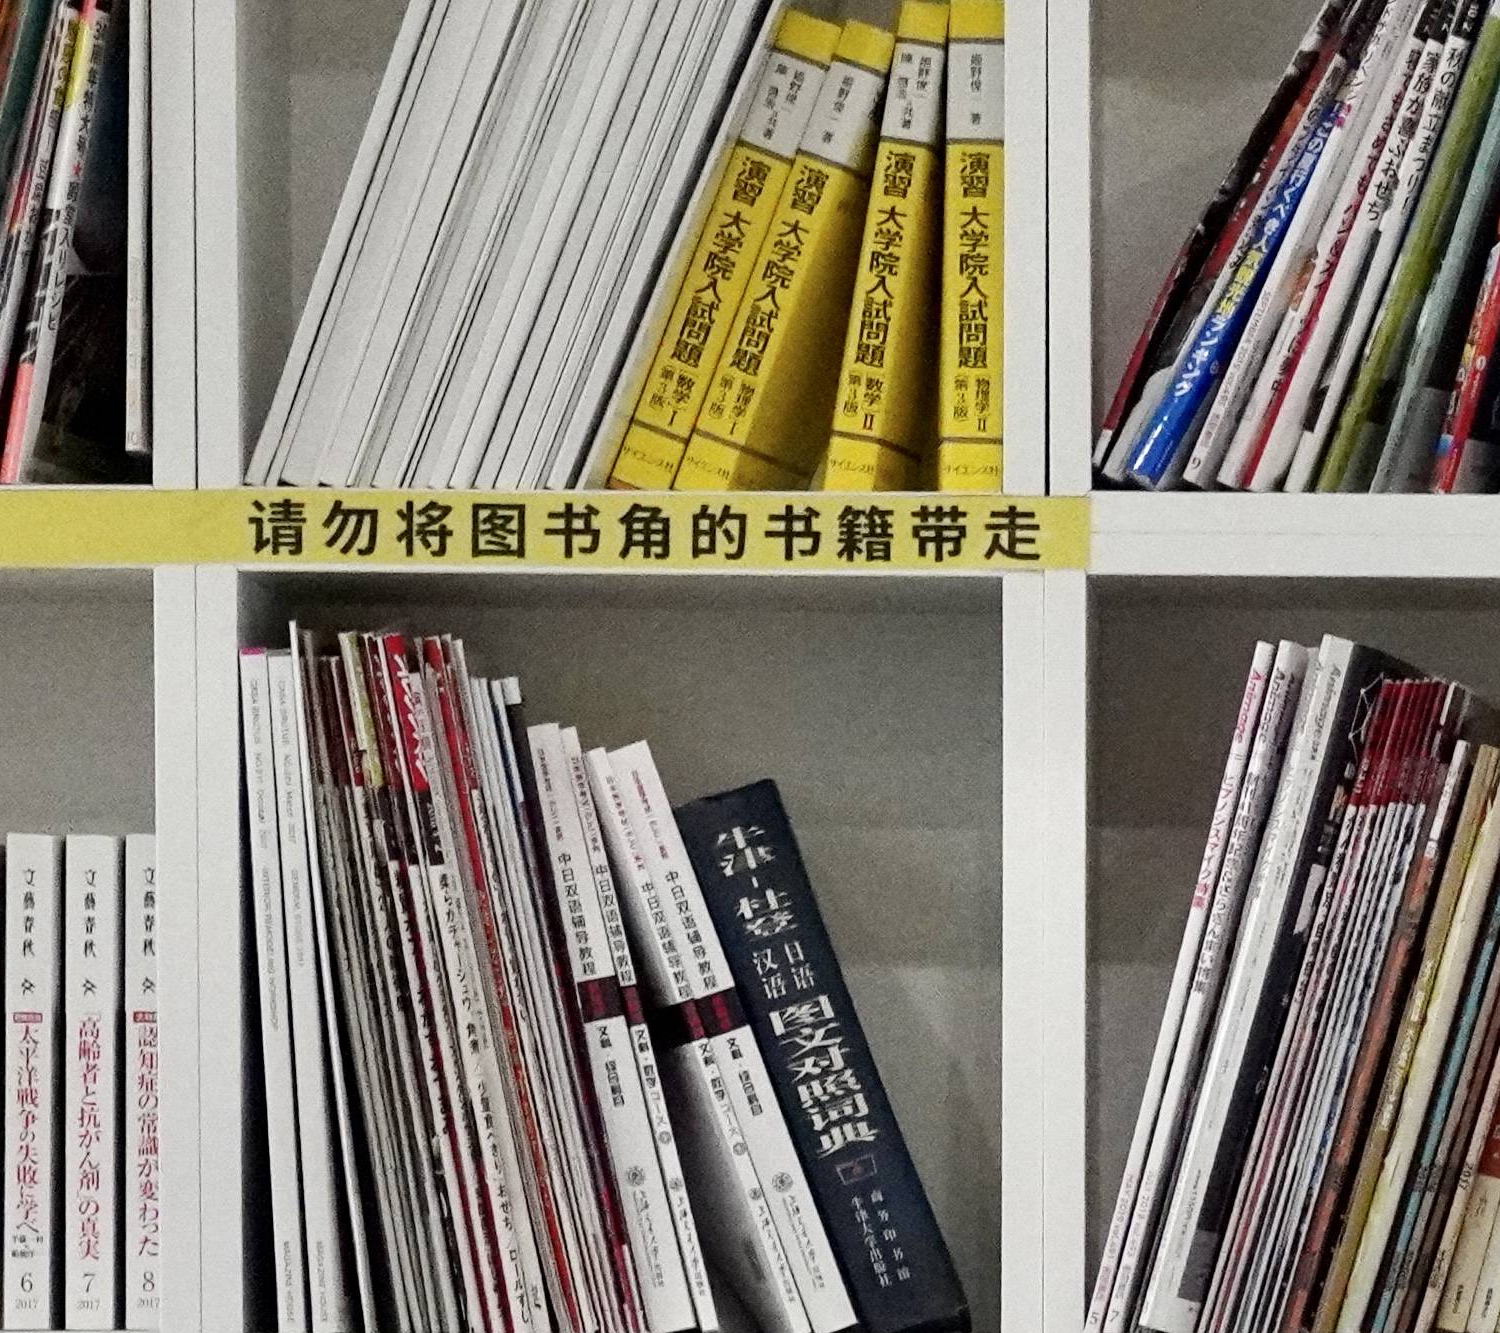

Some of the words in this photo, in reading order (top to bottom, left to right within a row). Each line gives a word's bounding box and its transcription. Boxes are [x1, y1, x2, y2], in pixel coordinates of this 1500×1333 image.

[732, 155, 771, 206] 演習
[790, 165, 829, 215] 演習
[883, 151, 915, 198] 演習
[960, 152, 989, 198] 演習
[671, 210, 751, 369] 大学院入試問題
[729, 219, 810, 376] 大学院入試問題
[855, 206, 907, 369] 大学院入試問題
[959, 206, 990, 369] 大学院入試問題
[249, 499, 1039, 562] 请勿将图书角的书籍带走
